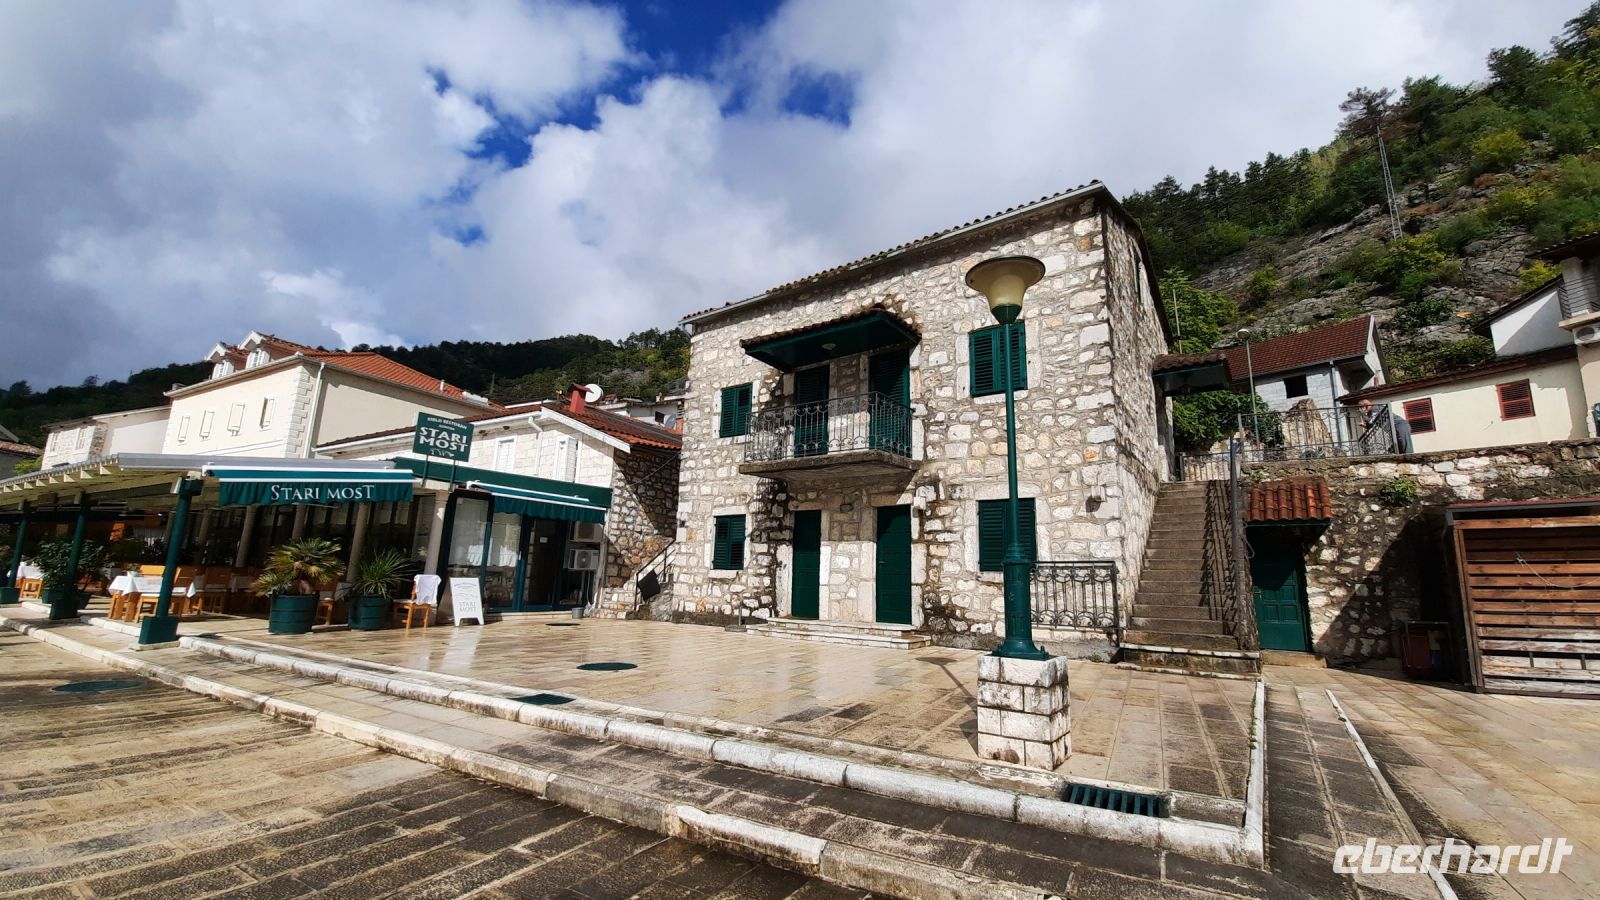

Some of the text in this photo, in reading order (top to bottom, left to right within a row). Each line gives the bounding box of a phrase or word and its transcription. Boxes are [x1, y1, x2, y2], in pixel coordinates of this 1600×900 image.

[419, 426, 467, 443] STARI
[419, 435, 468, 452] MOST
[271, 484, 375, 501] STARI MOST
